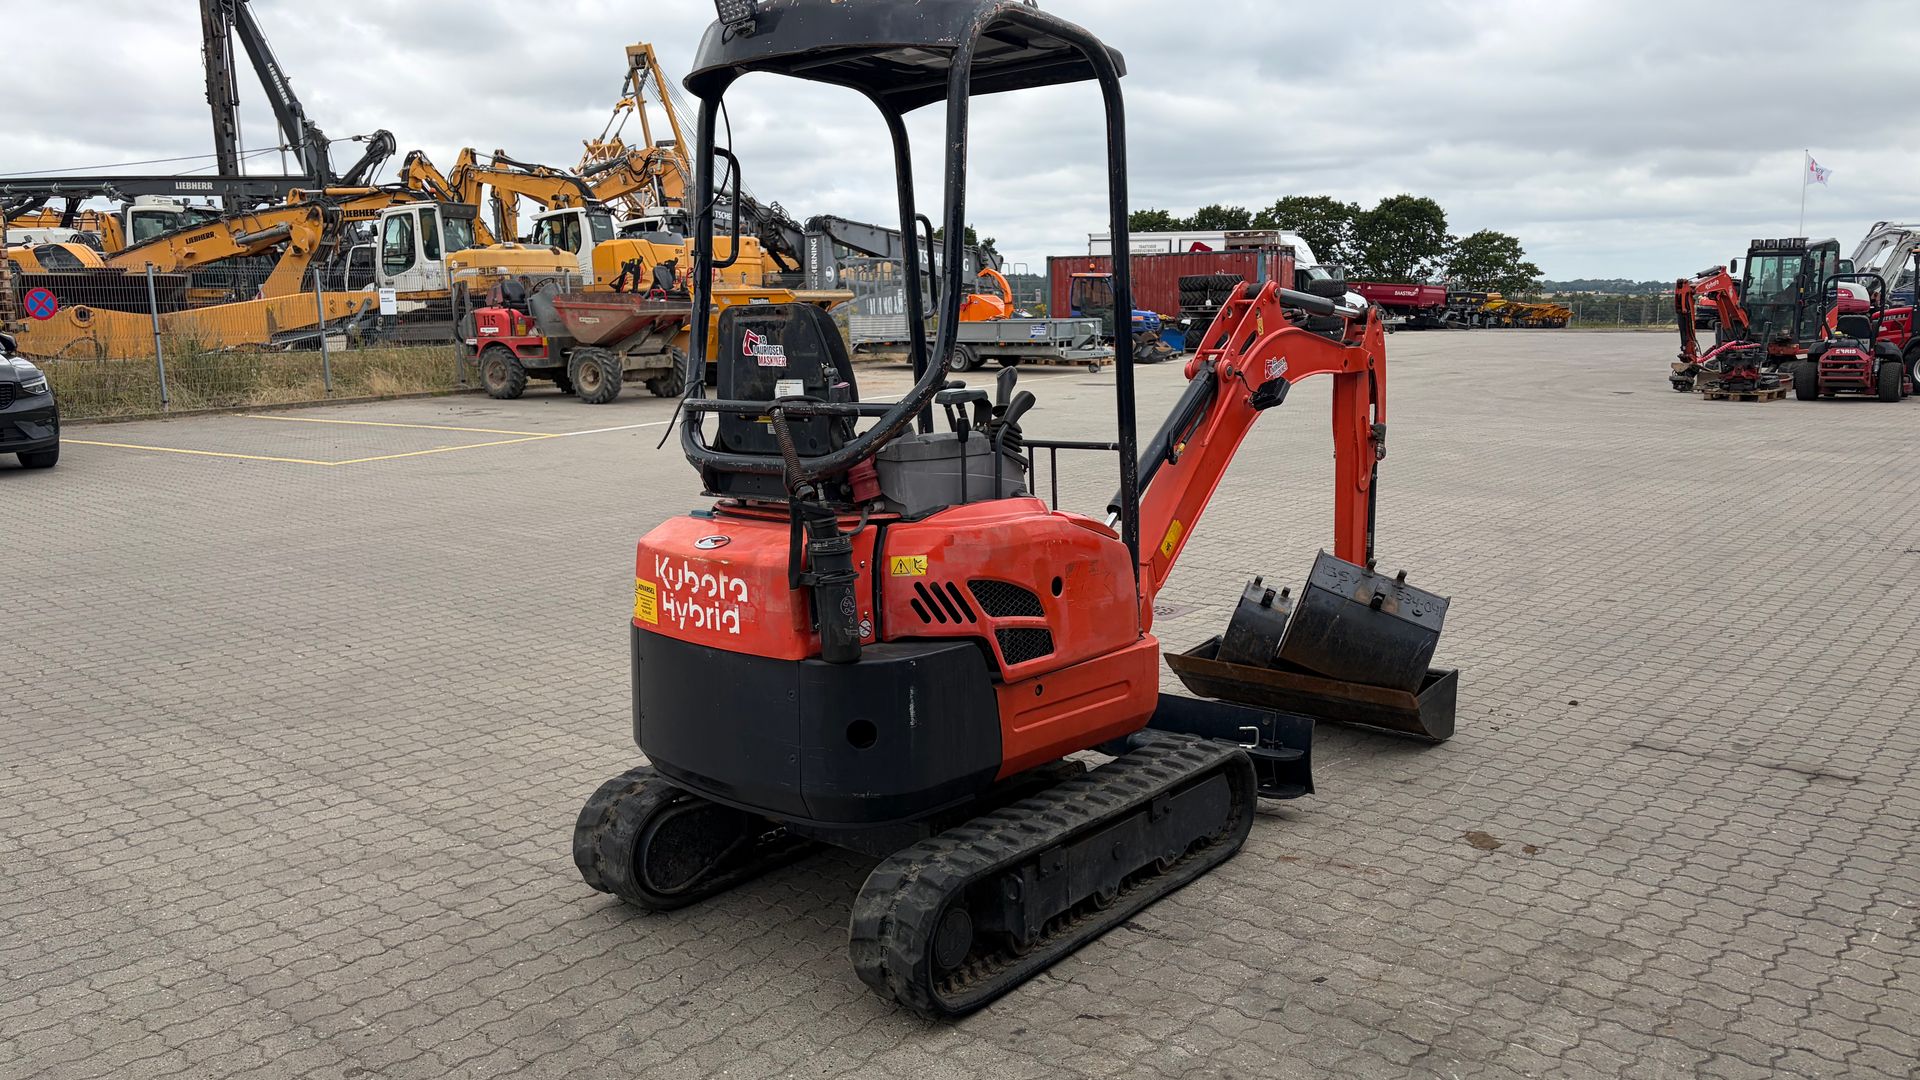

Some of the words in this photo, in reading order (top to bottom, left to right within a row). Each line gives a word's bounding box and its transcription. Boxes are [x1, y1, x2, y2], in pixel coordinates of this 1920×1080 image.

[267, 62, 290, 106] LIEBHERR
[175, 181, 214, 190] LIEBHERR
[185, 231, 215, 245] LIEBHERR
[483, 315, 496, 326] 115
[753, 345, 784, 356] LAURIDSEN
[758, 355, 786, 366] MASKINER
[655, 553, 749, 603] Kubota
[662, 590, 741, 635] Hybrid
